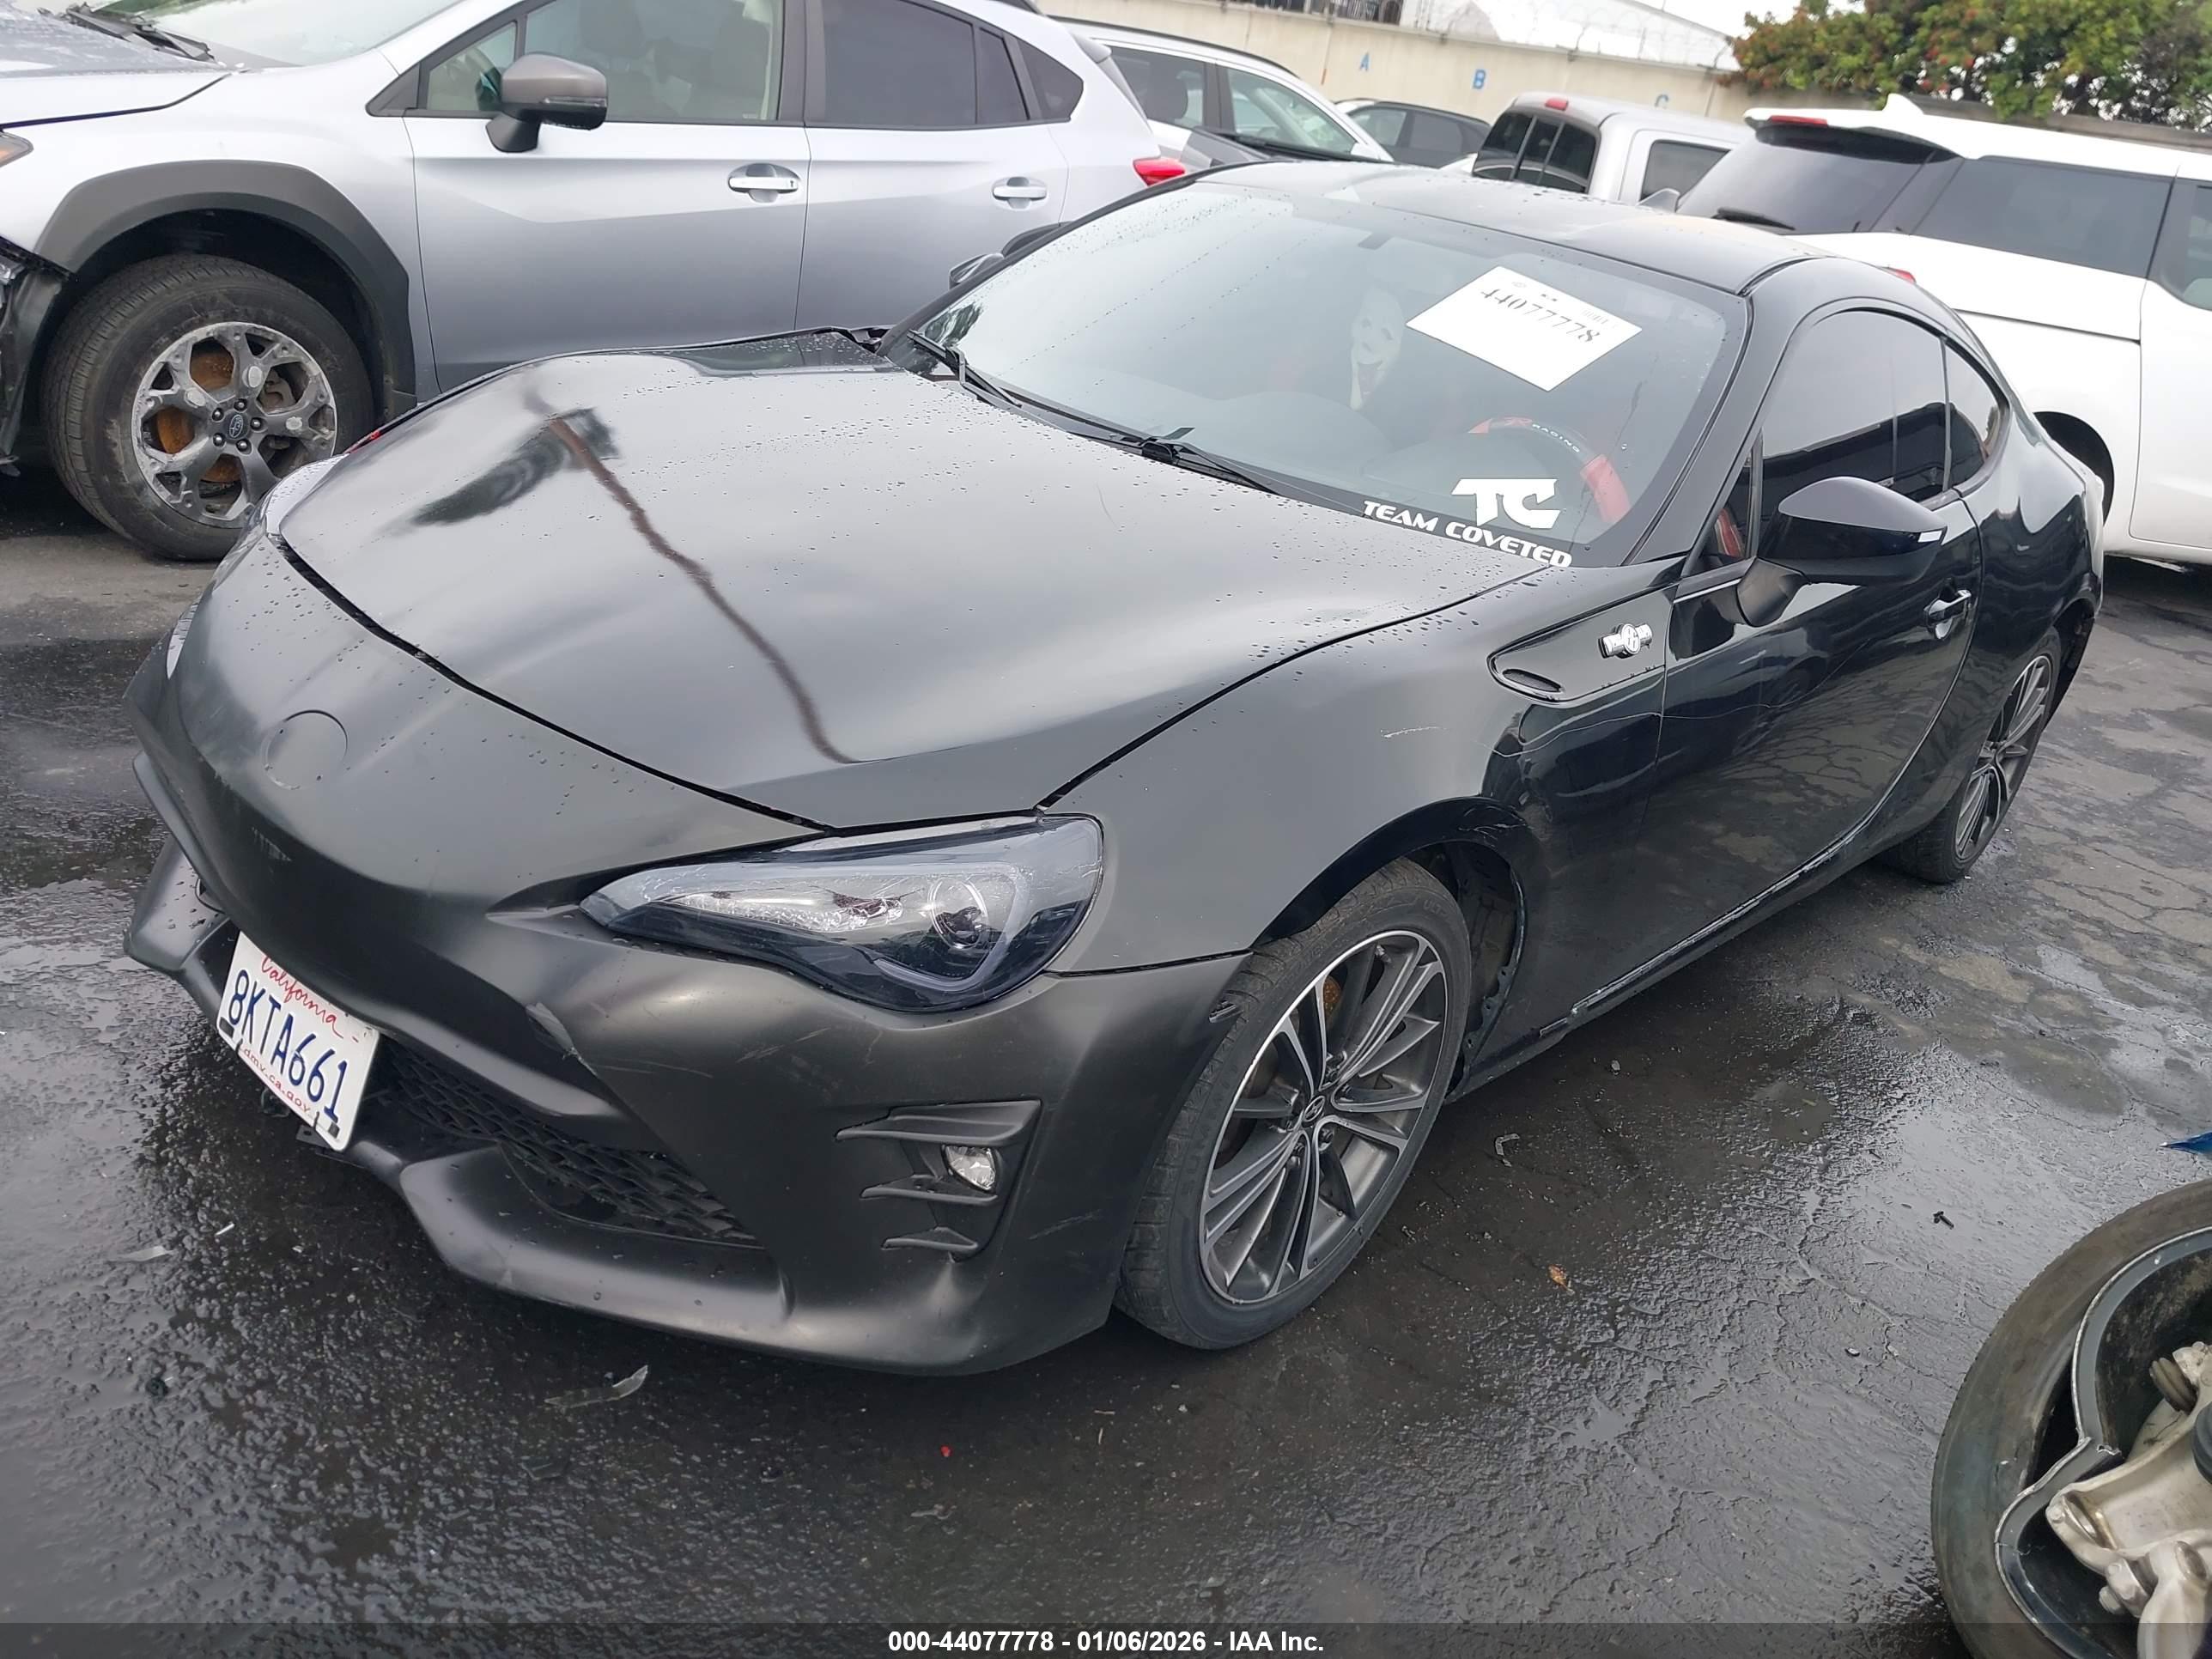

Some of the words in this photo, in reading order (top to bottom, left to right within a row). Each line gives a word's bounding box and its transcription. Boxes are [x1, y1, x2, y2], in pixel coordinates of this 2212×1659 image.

[1358, 52, 1370, 71] A
[1472, 69, 1486, 89] B
[1480, 288, 1601, 343] 44077778
[1451, 478, 1560, 530] TC
[1364, 500, 1439, 532] TEAM
[1445, 521, 1573, 568] COVETED
[261, 956, 343, 1039] California
[228, 969, 348, 1124] 8KTA661
